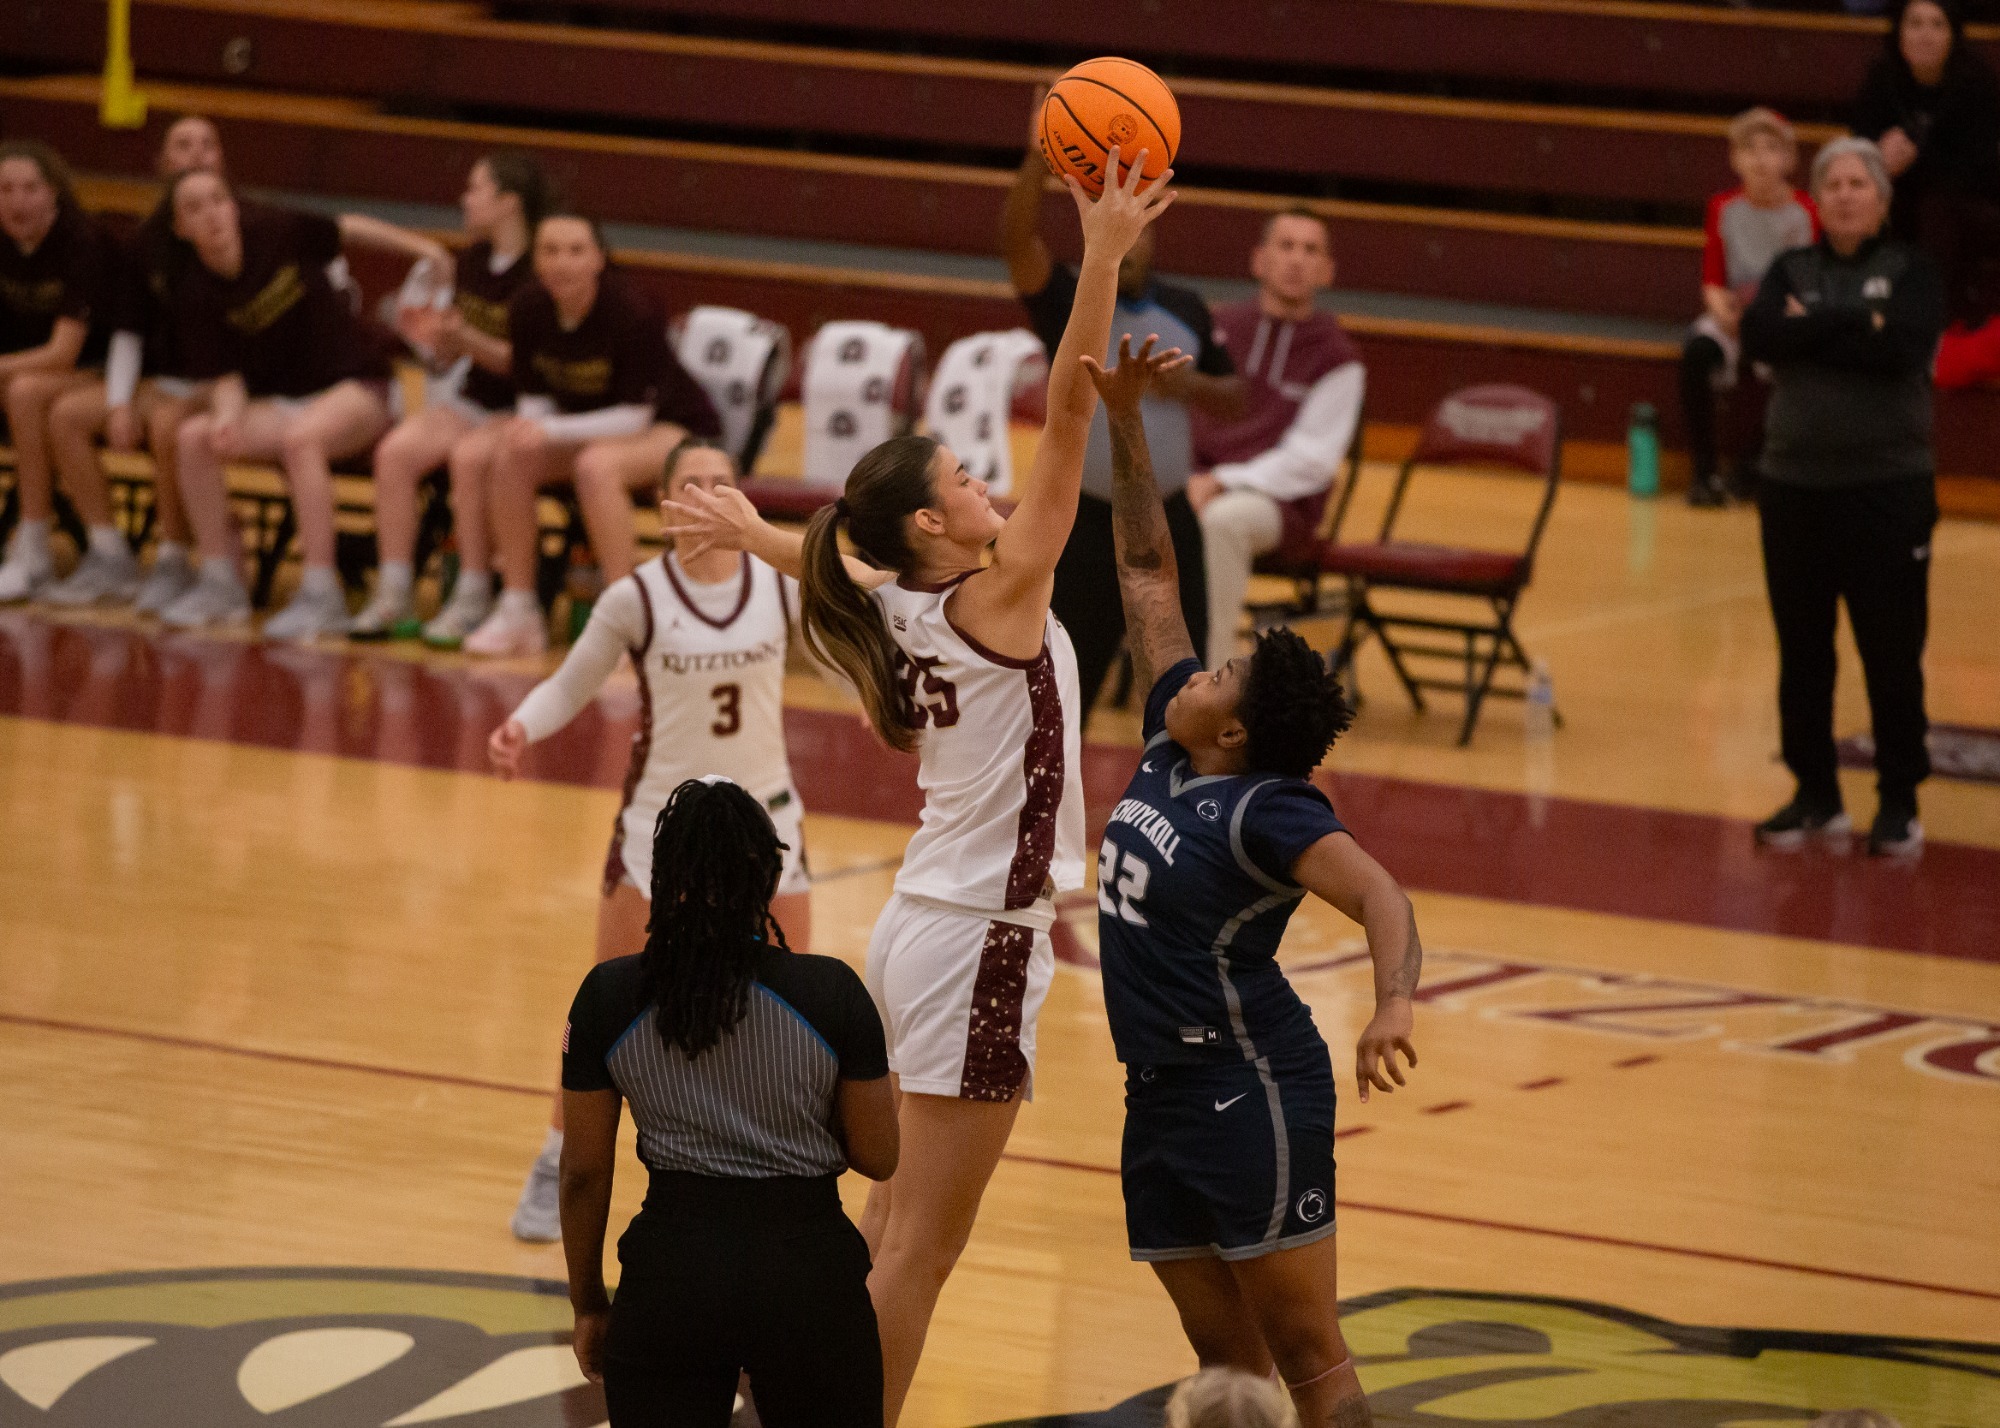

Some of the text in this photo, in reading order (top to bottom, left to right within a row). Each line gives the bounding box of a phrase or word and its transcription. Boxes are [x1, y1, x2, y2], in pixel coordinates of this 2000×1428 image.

[711, 684, 740, 736] 3
[1098, 836, 1151, 928] 22
[1208, 1031, 1217, 1040] M
